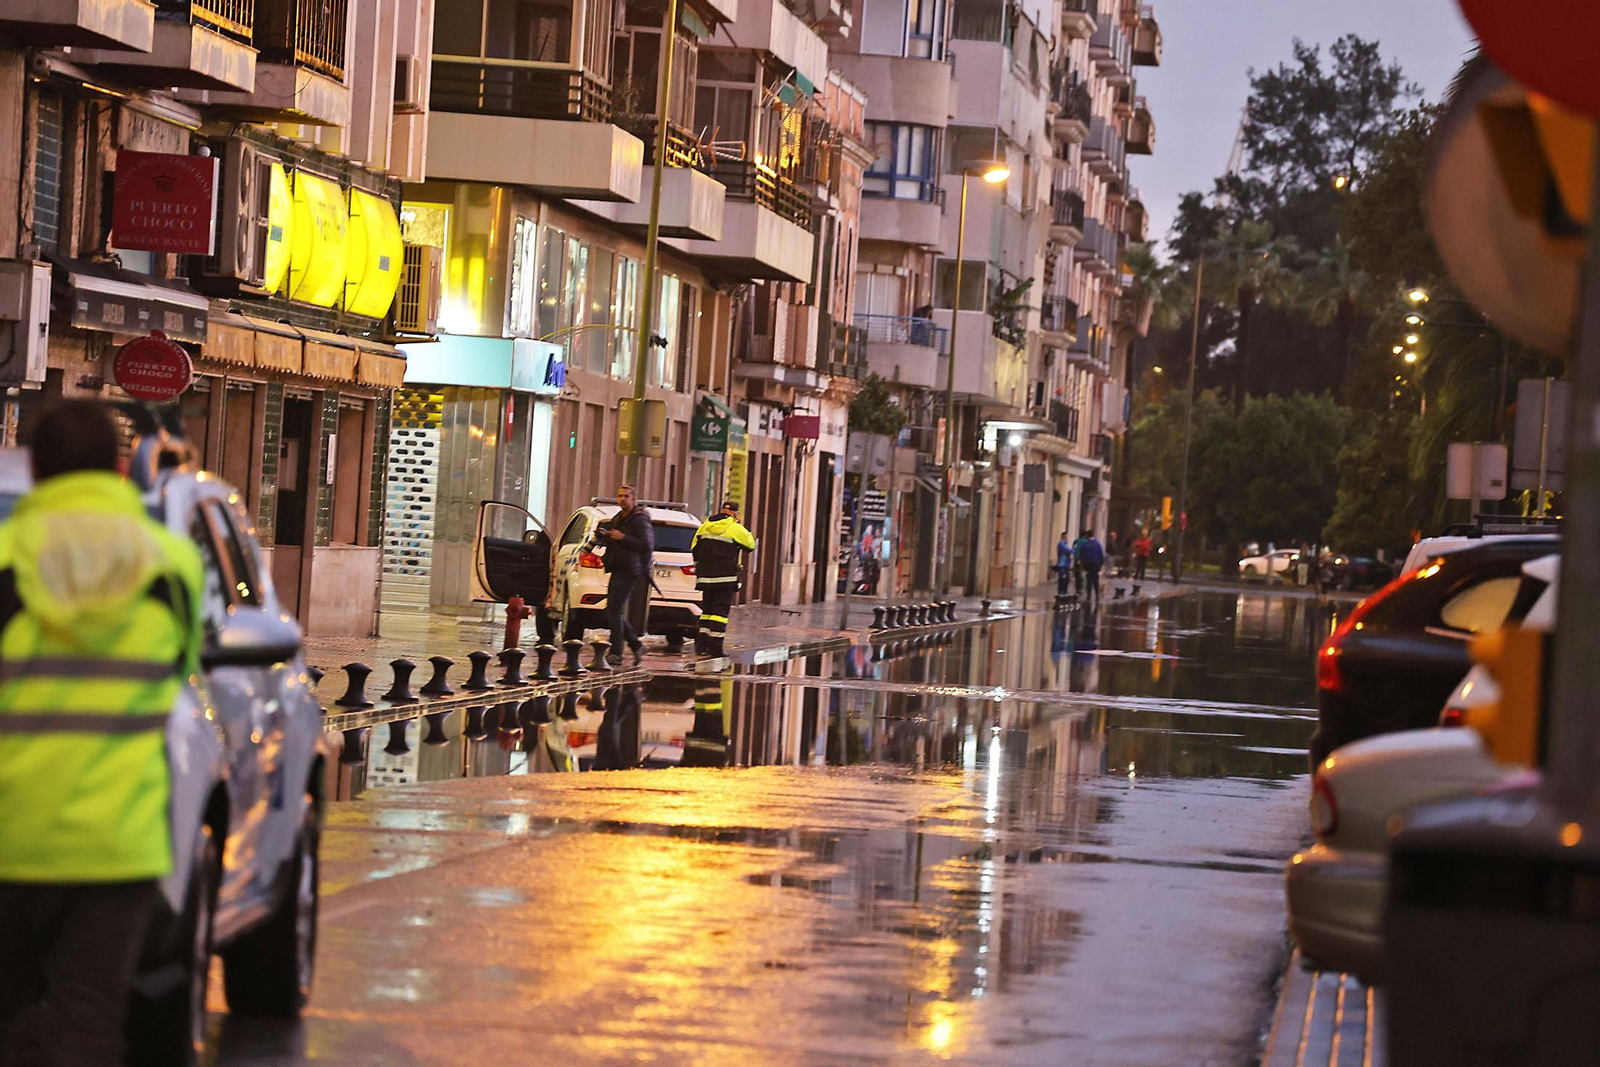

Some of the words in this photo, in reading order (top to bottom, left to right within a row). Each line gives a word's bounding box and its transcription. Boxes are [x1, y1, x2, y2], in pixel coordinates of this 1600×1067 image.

[130, 200, 197, 215] PUERTO
[131, 215, 194, 230] CHOCO
[118, 234, 199, 248] RESTAURANTE
[127, 361, 177, 372] PUERTO
[129, 368, 173, 379] CHOCO
[121, 382, 178, 395] RESTAURANTE
